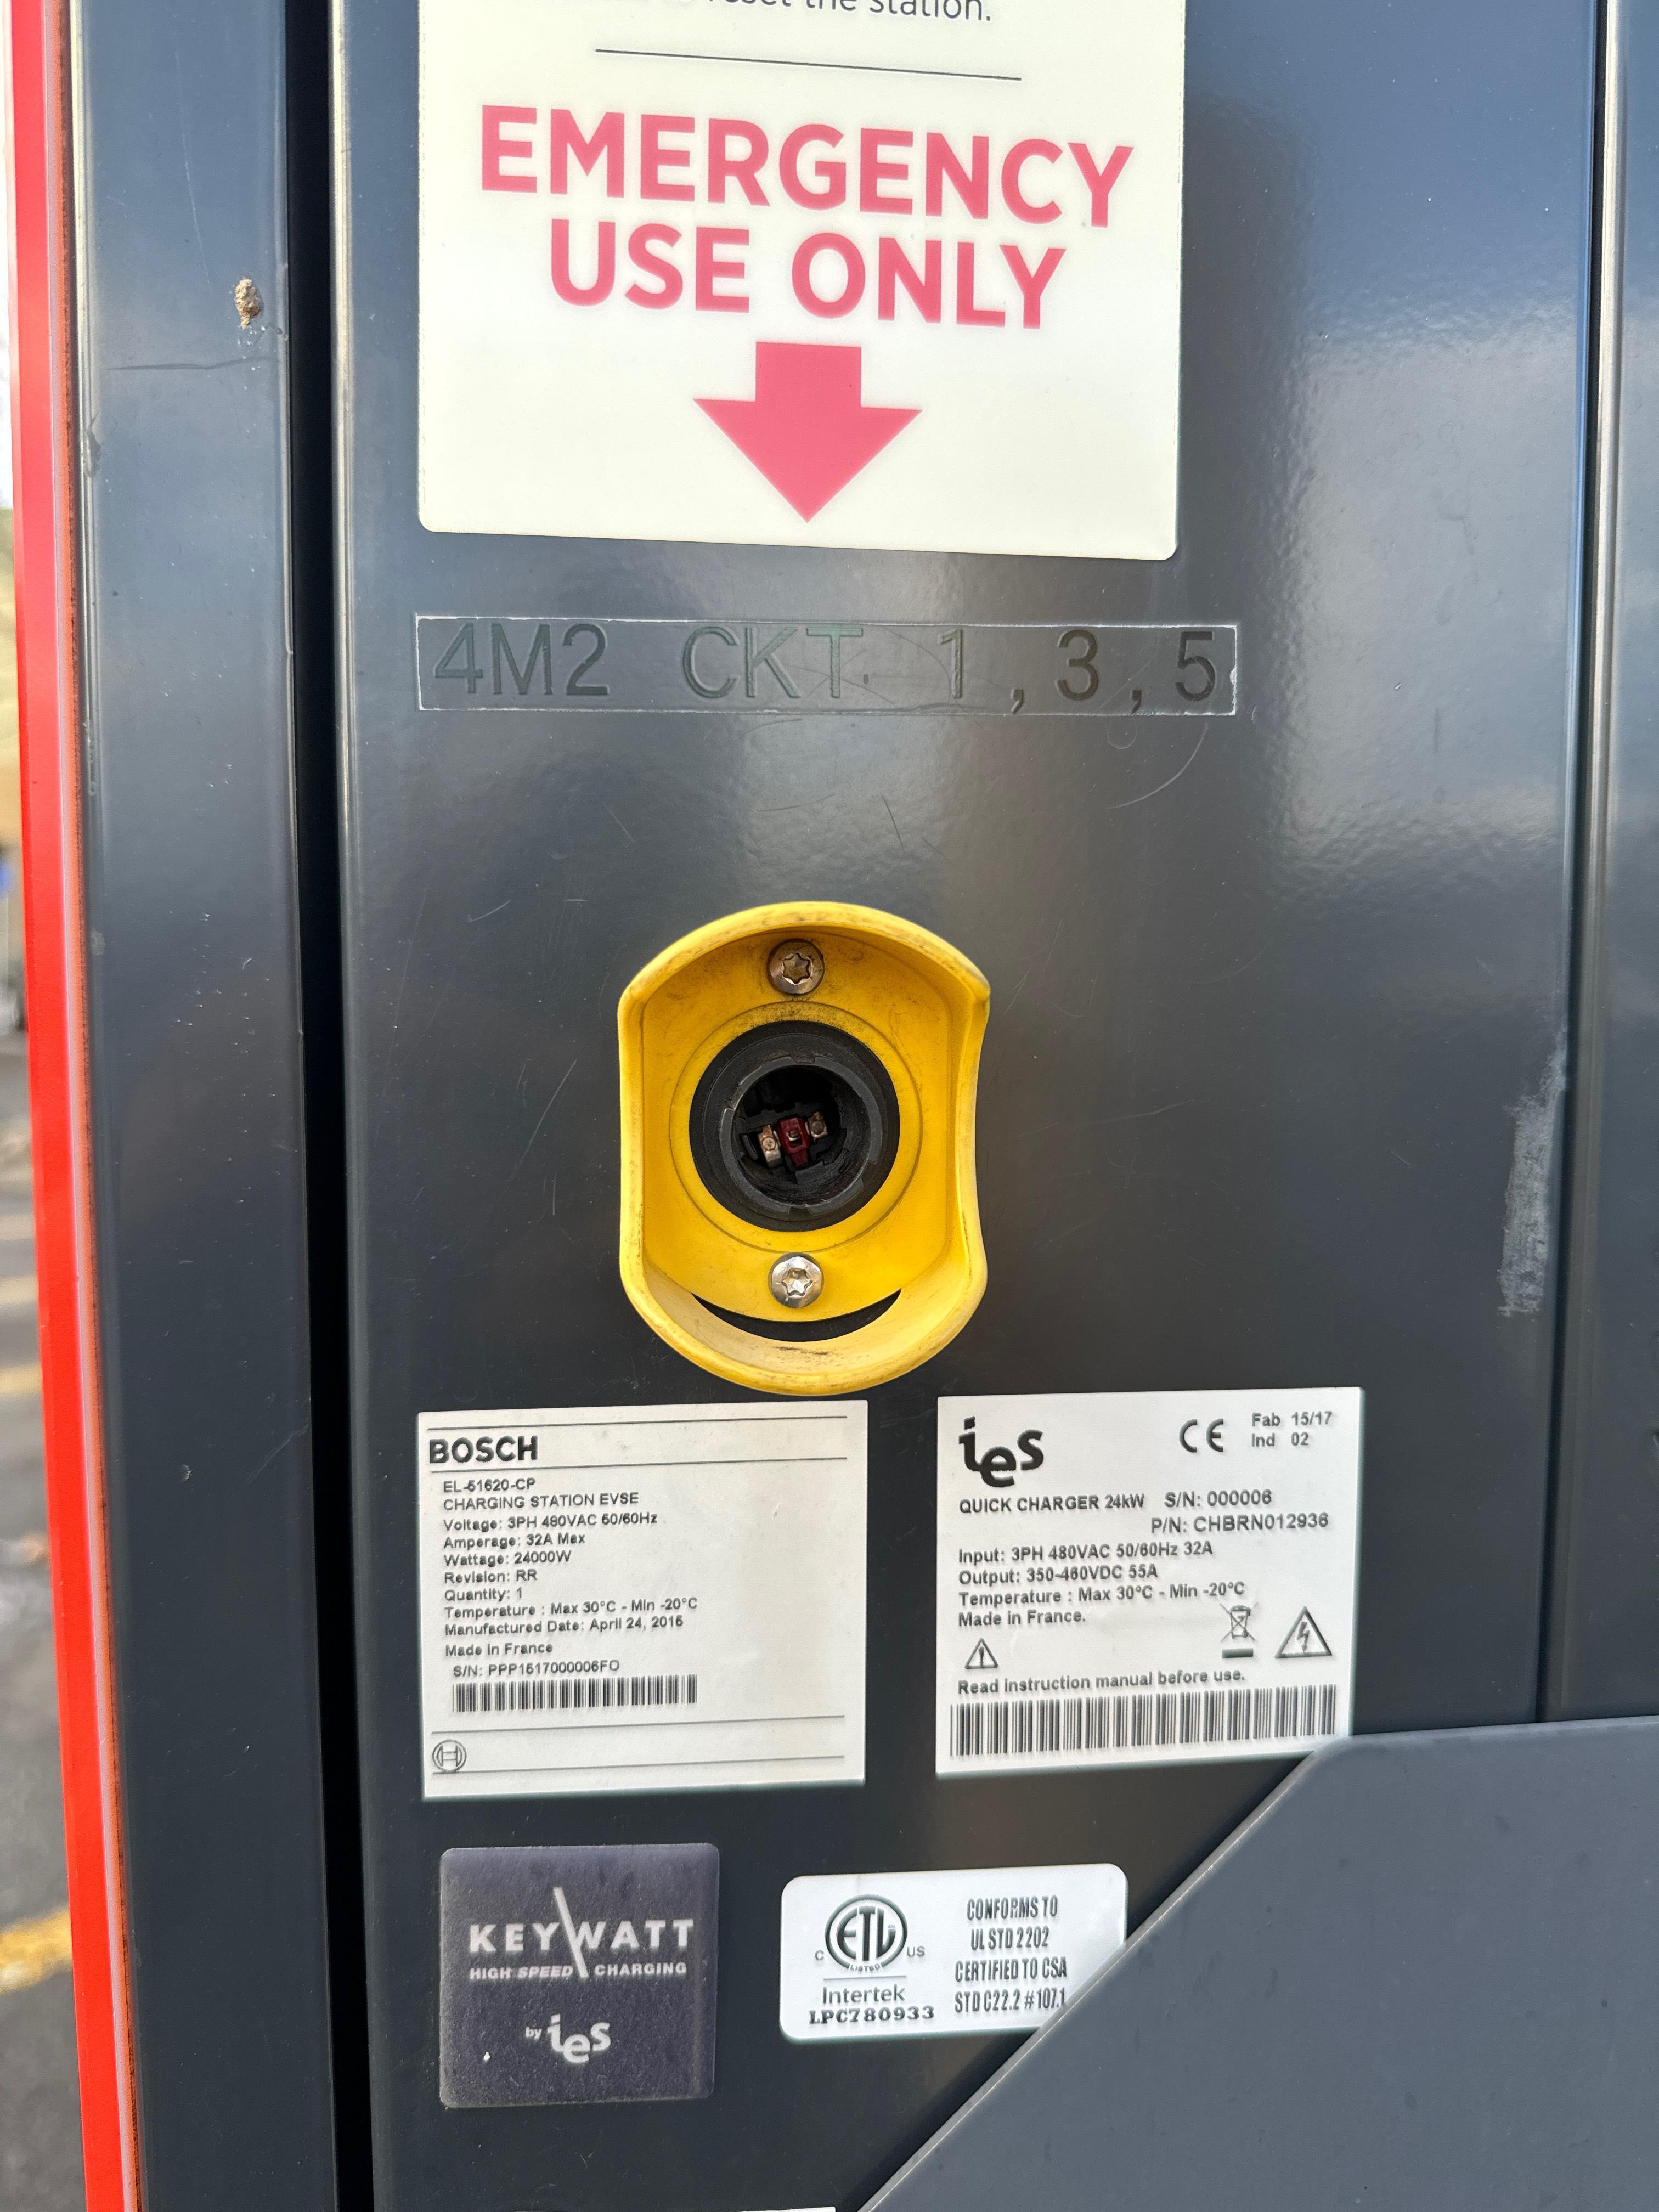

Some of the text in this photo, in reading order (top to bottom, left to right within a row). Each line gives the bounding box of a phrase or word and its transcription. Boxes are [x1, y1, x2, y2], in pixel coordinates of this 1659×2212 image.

[481, 104, 1134, 228] EMERGENCY
[550, 218, 1066, 329] USE ONLY
[435, 623, 608, 699] 4M2
[681, 625, 863, 700] CKT
[1251, 1411, 1333, 1427] Fab 15/17
[1179, 1418, 1224, 1453] CE
[1251, 1432, 1309, 1447] Ind 02
[429, 1435, 538, 1464] BOSCH
[958, 1416, 1045, 1488] ies
[443, 1492, 639, 1510] CHARGING STATION EVSE
[959, 1494, 1144, 1514] QUICK CHARGER 24kW
[1164, 1489, 1272, 1508] S/N: 000006
[443, 1518, 502, 1532] Voltage:
[507, 1515, 537, 1528] 3PH
[541, 1514, 597, 1527] 480VAC
[1151, 1511, 1329, 1533] P/N: CHBRN012936
[443, 1533, 585, 1550] Amperage: 32A Max
[444, 1550, 572, 1567] Wattage: 24000W
[959, 1541, 1213, 1566] Input: 3PH 480VAC 50/60Hz 32A
[444, 1568, 538, 1584] Revision: RR
[959, 1563, 1158, 1587] Output: 350-460VDC 55A
[445, 1587, 522, 1603] Quantity: 1
[960, 1589, 1061, 1608] Temperature
[1079, 1588, 1110, 1601] Max
[1116, 1585, 1152, 1600] 30°C
[1170, 1583, 1197, 1598] Min
[1203, 1581, 1245, 1596] -20°C
[444, 1606, 536, 1620] Temperature
[551, 1602, 579, 1615] Max
[583, 1600, 616, 1613] 30°C
[631, 1599, 655, 1612] Min
[660, 1597, 698, 1611] -20°C
[959, 1609, 1086, 1627] Made in France.
[445, 1621, 542, 1636] Manufactured
[548, 1618, 584, 1633] Date:
[589, 1618, 622, 1632] April
[626, 1617, 646, 1632] 24,
[445, 1642, 553, 1657] Made in France
[453, 1664, 483, 1678] S/N:
[958, 1669, 1245, 1694] Read instruction manual before use.
[967, 1895, 1058, 1920] CONFORMS TO
[971, 1926, 1049, 1950] UL STD 2202
[906, 1946, 925, 1957] US
[470, 1962, 687, 1980] HIGH SPEED CHARGING
[850, 1963, 881, 1972] LISTED
[955, 1956, 1066, 1982] CERTIFIED TO CSA
[823, 1984, 905, 2004] Intertek
[955, 1991, 980, 2013] STD
[984, 1988, 1020, 2012] C22.2
[809, 2005, 934, 2024] LPC780933
[525, 2013, 611, 2063] by ies
